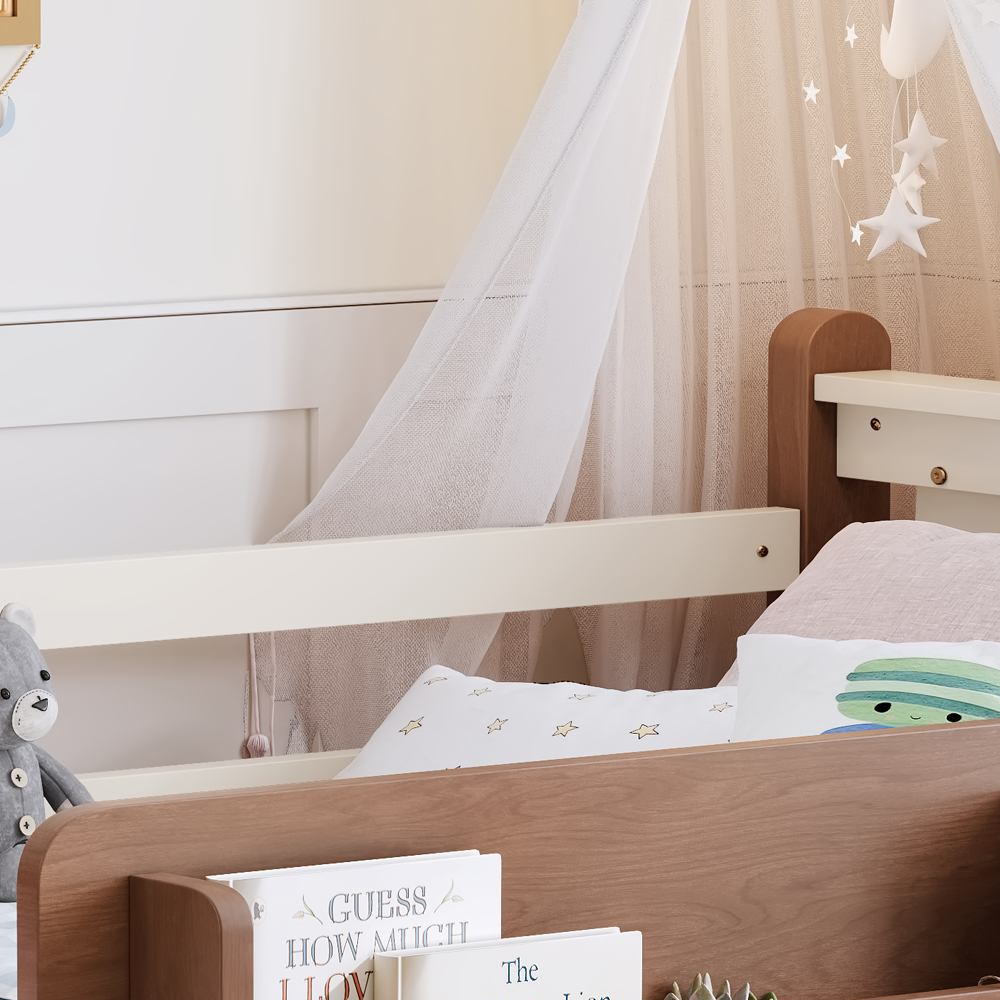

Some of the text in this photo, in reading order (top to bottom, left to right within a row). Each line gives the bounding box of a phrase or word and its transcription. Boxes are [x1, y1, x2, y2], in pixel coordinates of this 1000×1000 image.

[328, 885, 427, 924] GUESS
[286, 921, 469, 969] HOW MUCH
[502, 957, 539, 984] The
